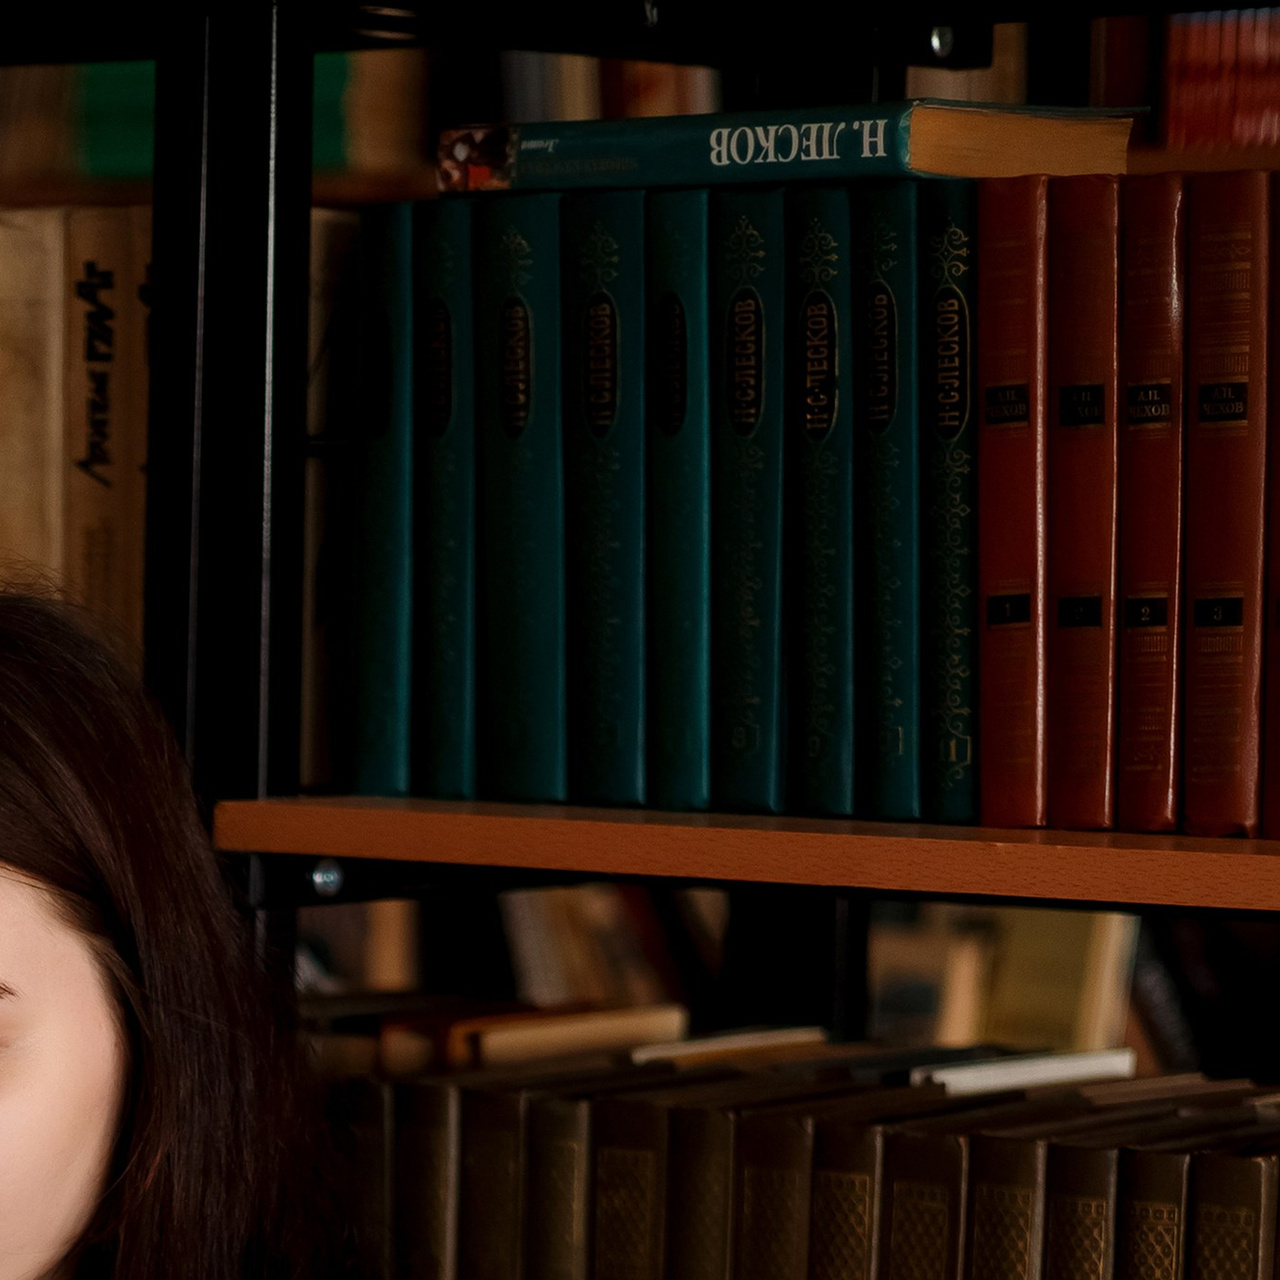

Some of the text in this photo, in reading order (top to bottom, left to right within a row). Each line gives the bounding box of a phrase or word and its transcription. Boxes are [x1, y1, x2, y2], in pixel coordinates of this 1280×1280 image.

[709, 118, 888, 165] Н. ЛЕСКОВ
[1129, 403, 1170, 419] ЧЕХОВ
[1203, 401, 1245, 416] ЧЕХОВ
[1139, 605, 1152, 621] 2
[1212, 606, 1223, 621] 3
